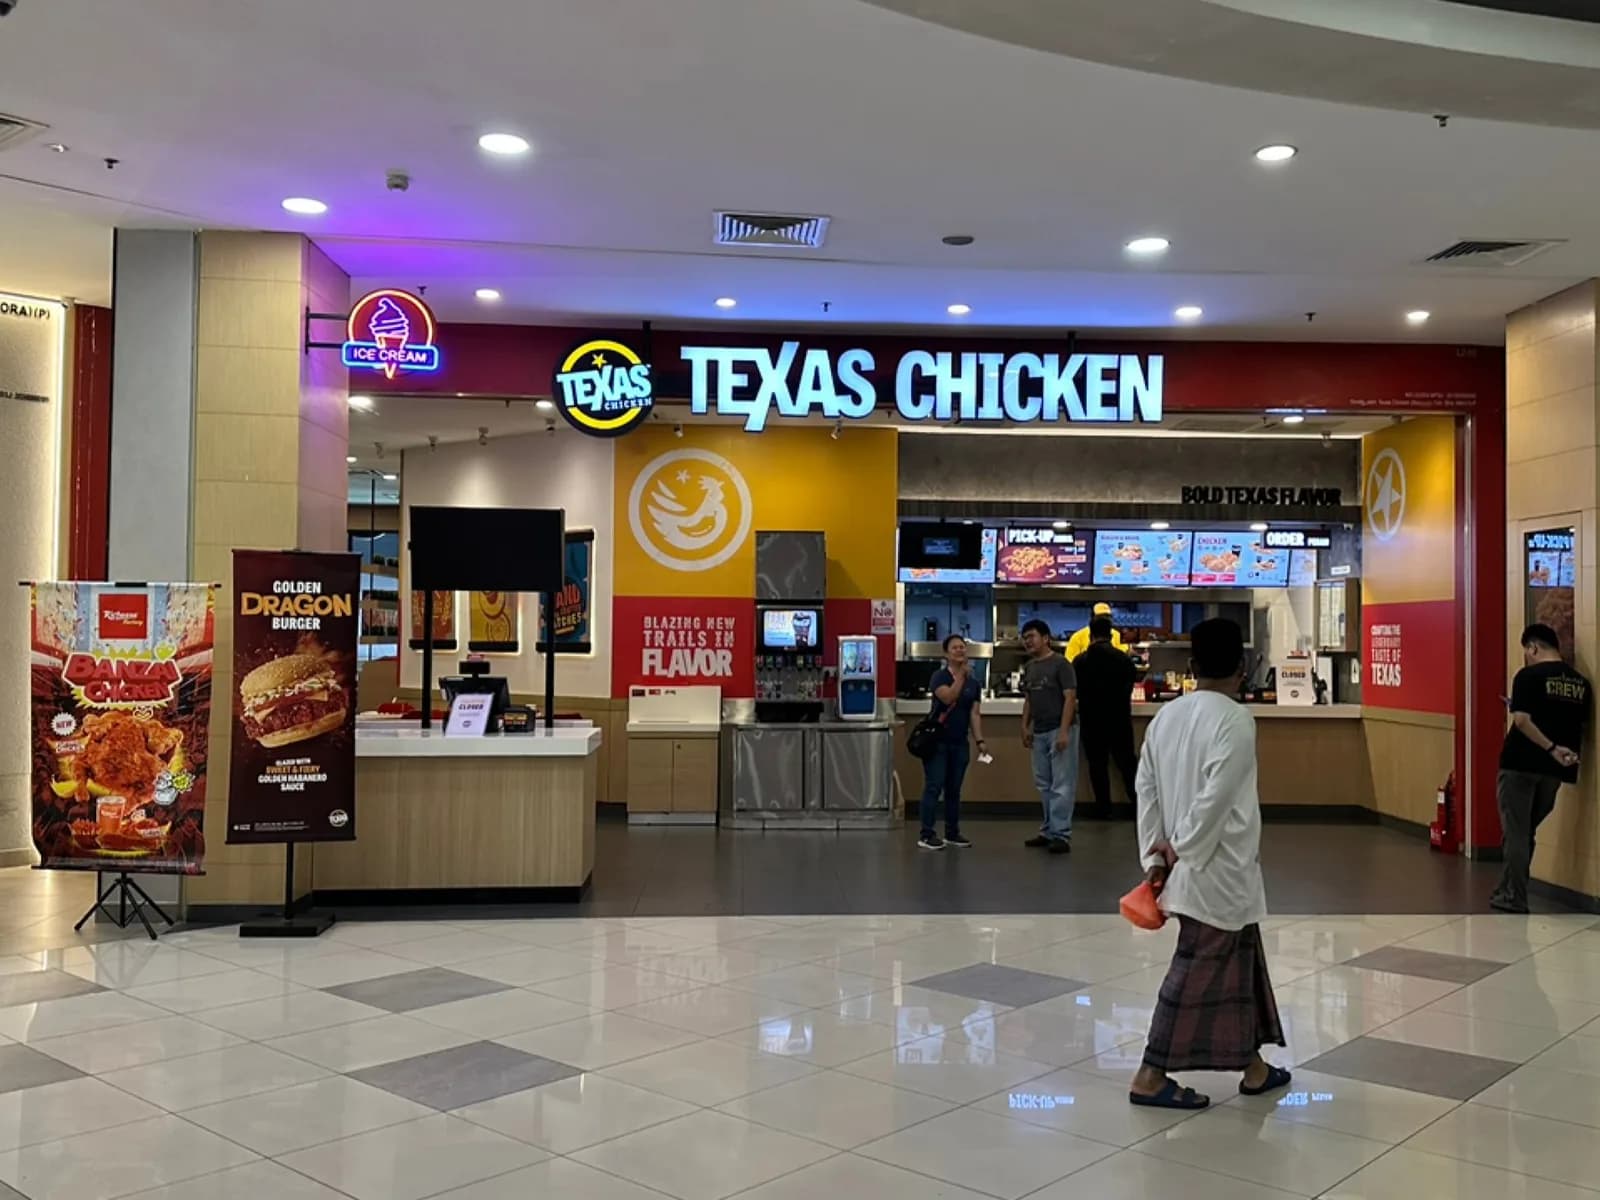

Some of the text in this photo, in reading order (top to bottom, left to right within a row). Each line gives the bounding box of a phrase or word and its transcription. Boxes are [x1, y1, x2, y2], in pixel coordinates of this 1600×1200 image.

[353, 348, 427, 363] ICE CREAM
[556, 364, 652, 411] TEXAS
[680, 341, 1164, 432] TEXAS CHICKEN
[604, 398, 652, 410] CHICKEN
[1181, 486, 1341, 507] BOLD TEXAS FLAVOR
[1009, 529, 1054, 543] PICK-UP
[1267, 532, 1304, 546] ORDER
[272, 580, 321, 594] GOLDEN
[241, 592, 352, 617] DRAGON
[272, 617, 320, 630] BURGER
[643, 616, 735, 629] BLAZING NEW
[643, 630, 734, 647] TRAILS IN
[642, 648, 733, 678] FLAVOR
[1371, 663, 1401, 687] TEXAS
[1546, 680, 1586, 700] CREW
